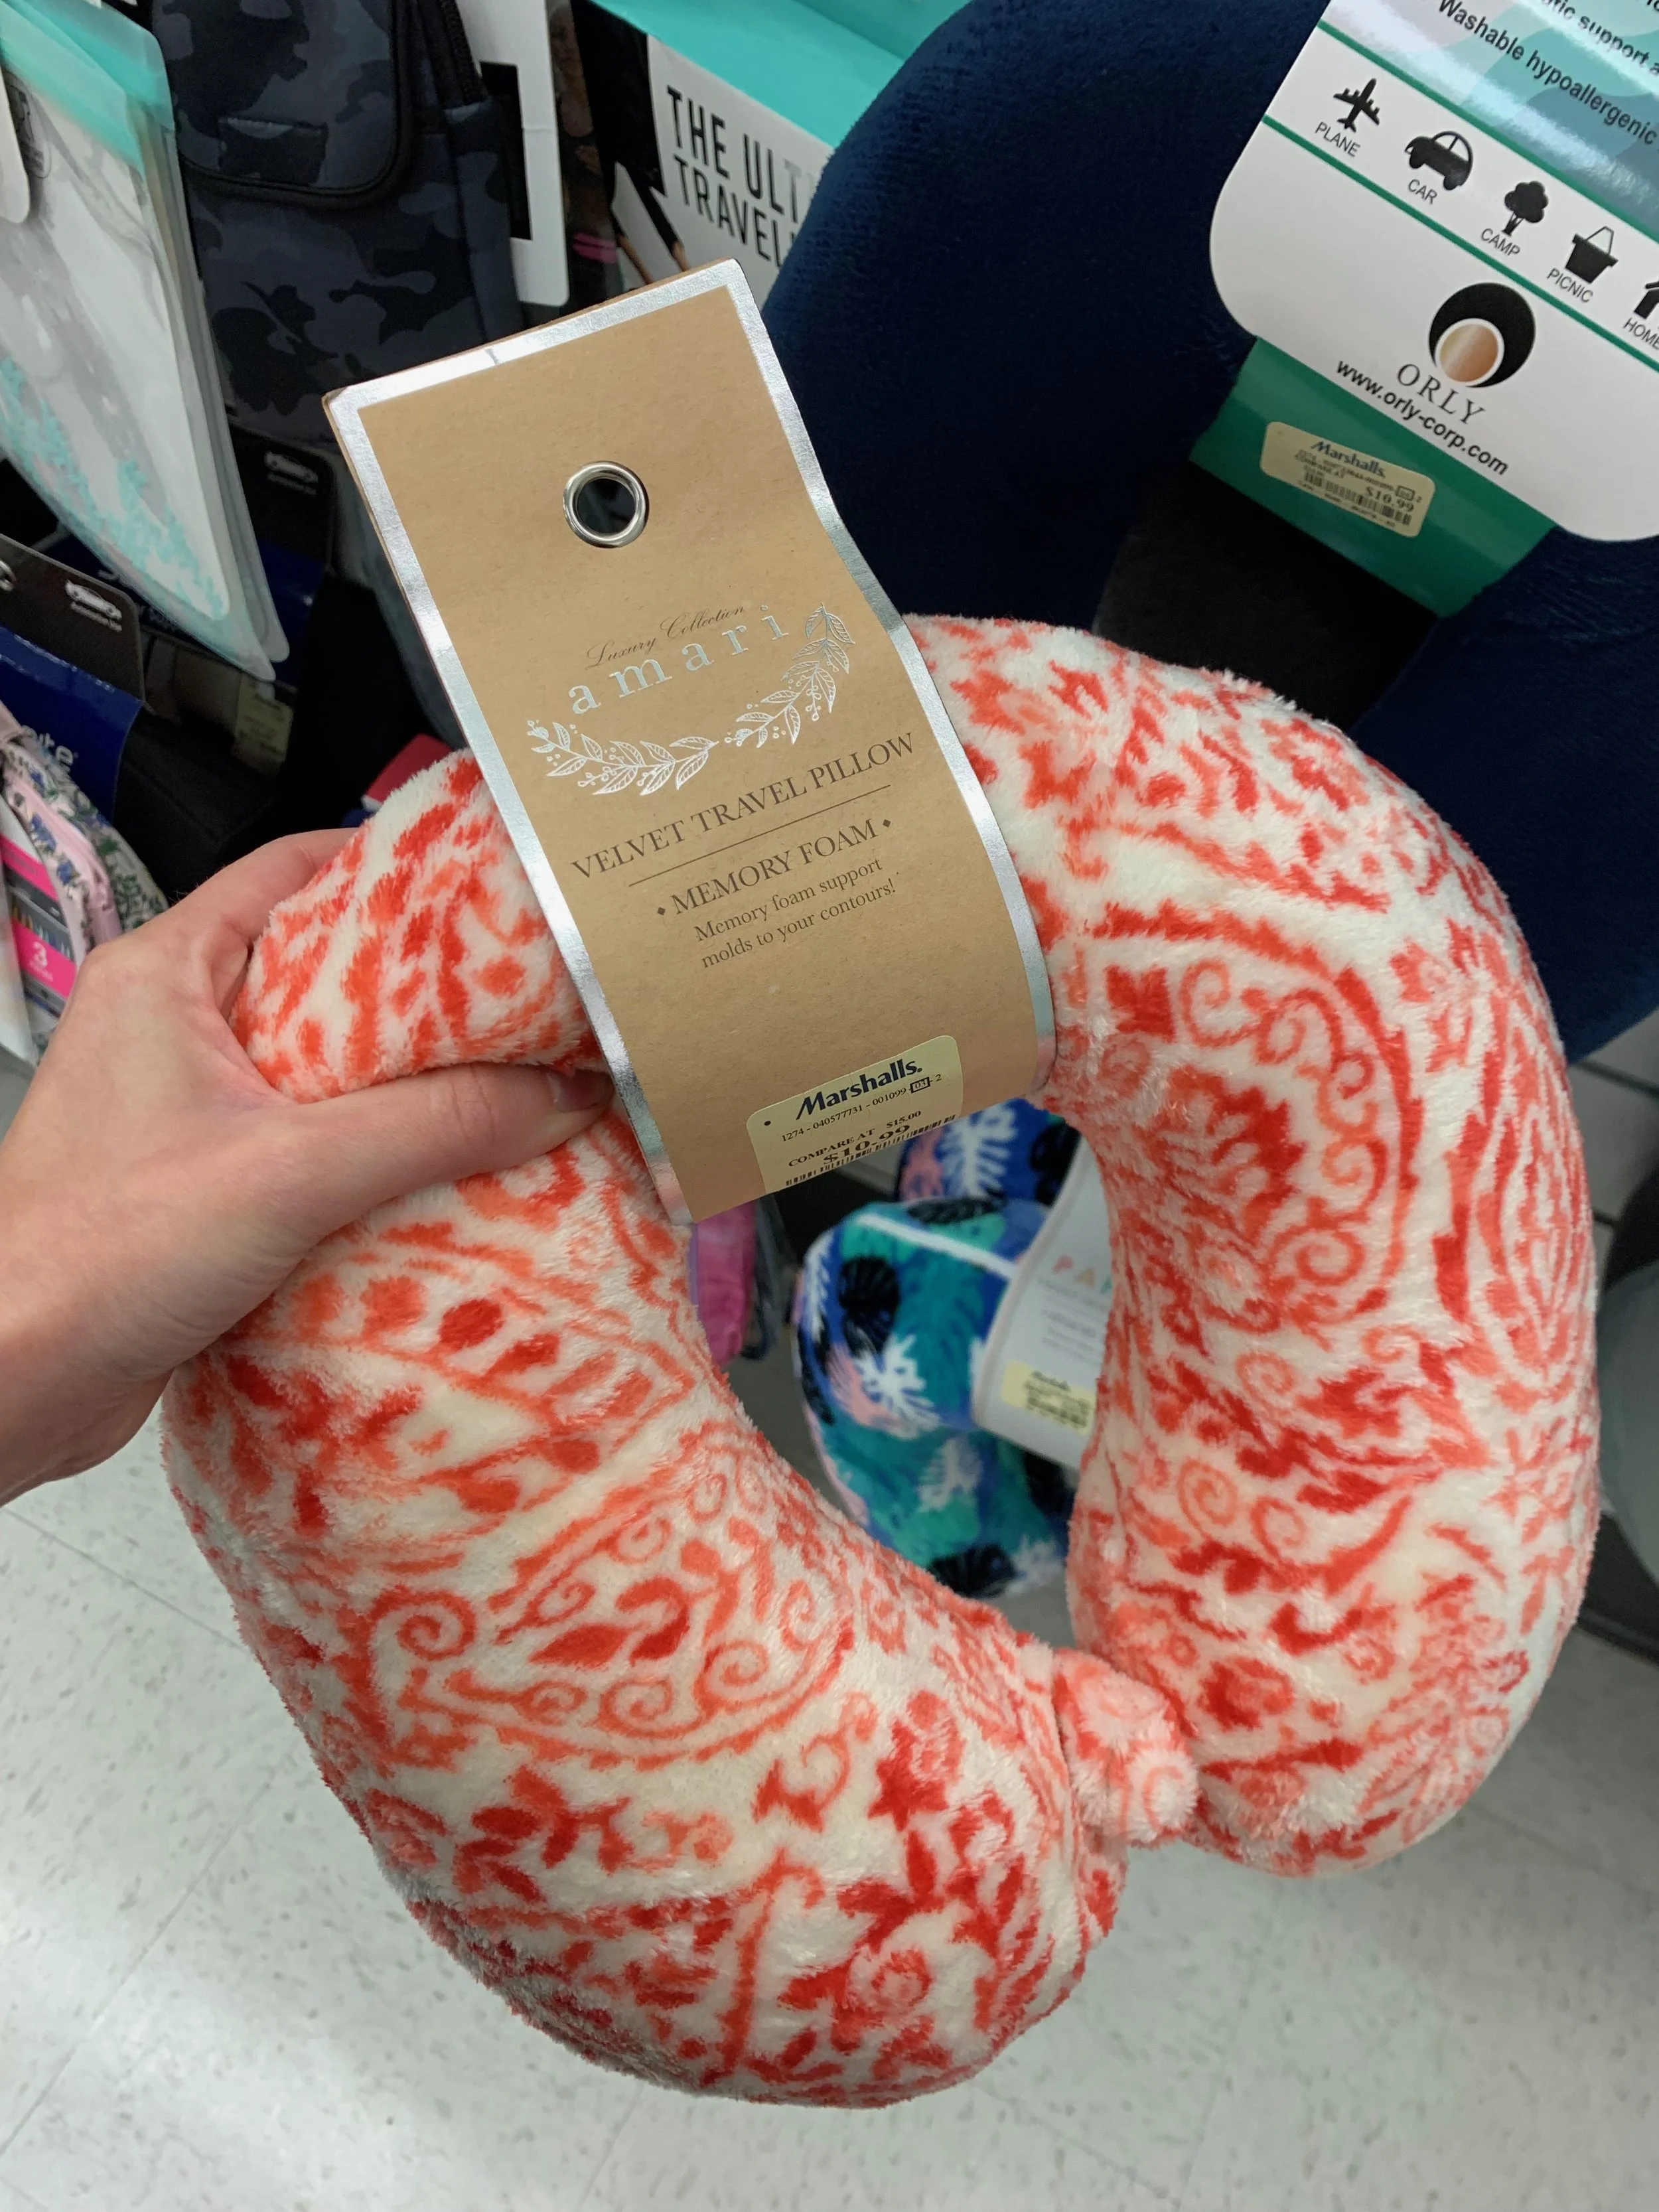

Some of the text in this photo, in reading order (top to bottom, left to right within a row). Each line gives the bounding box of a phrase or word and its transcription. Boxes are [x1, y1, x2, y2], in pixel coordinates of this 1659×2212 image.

[1579, 15, 1650, 65] support
[1439, 0, 1658, 145] Washable hypoallergenic
[668, 84, 729, 179] THE
[1315, 121, 1361, 157] PLANE
[1408, 179, 1438, 205] CAR
[1480, 228, 1520, 256] CAMP
[1547, 268, 1593, 303] PICNIC
[1336, 360, 1509, 475] www.orly-corp.com
[1397, 364, 1486, 425] ORLY
[1365, 486, 1414, 512] $10.99
[569, 605, 789, 715] amari
[585, 607, 744, 670] Luxury Collection
[573, 733, 914, 880] VELVET TRAVEL PILLOW
[669, 818, 879, 915] MEMORY FOAM
[694, 857, 883, 942] Memory foam support
[701, 877, 897, 968] molds to your contours!
[782, 1128, 805, 1142] 1274
[812, 1104, 863, 1130] 040577731
[872, 1087, 906, 1106] 001099
[788, 1110, 922, 1167] COMPARE AT $15.00
